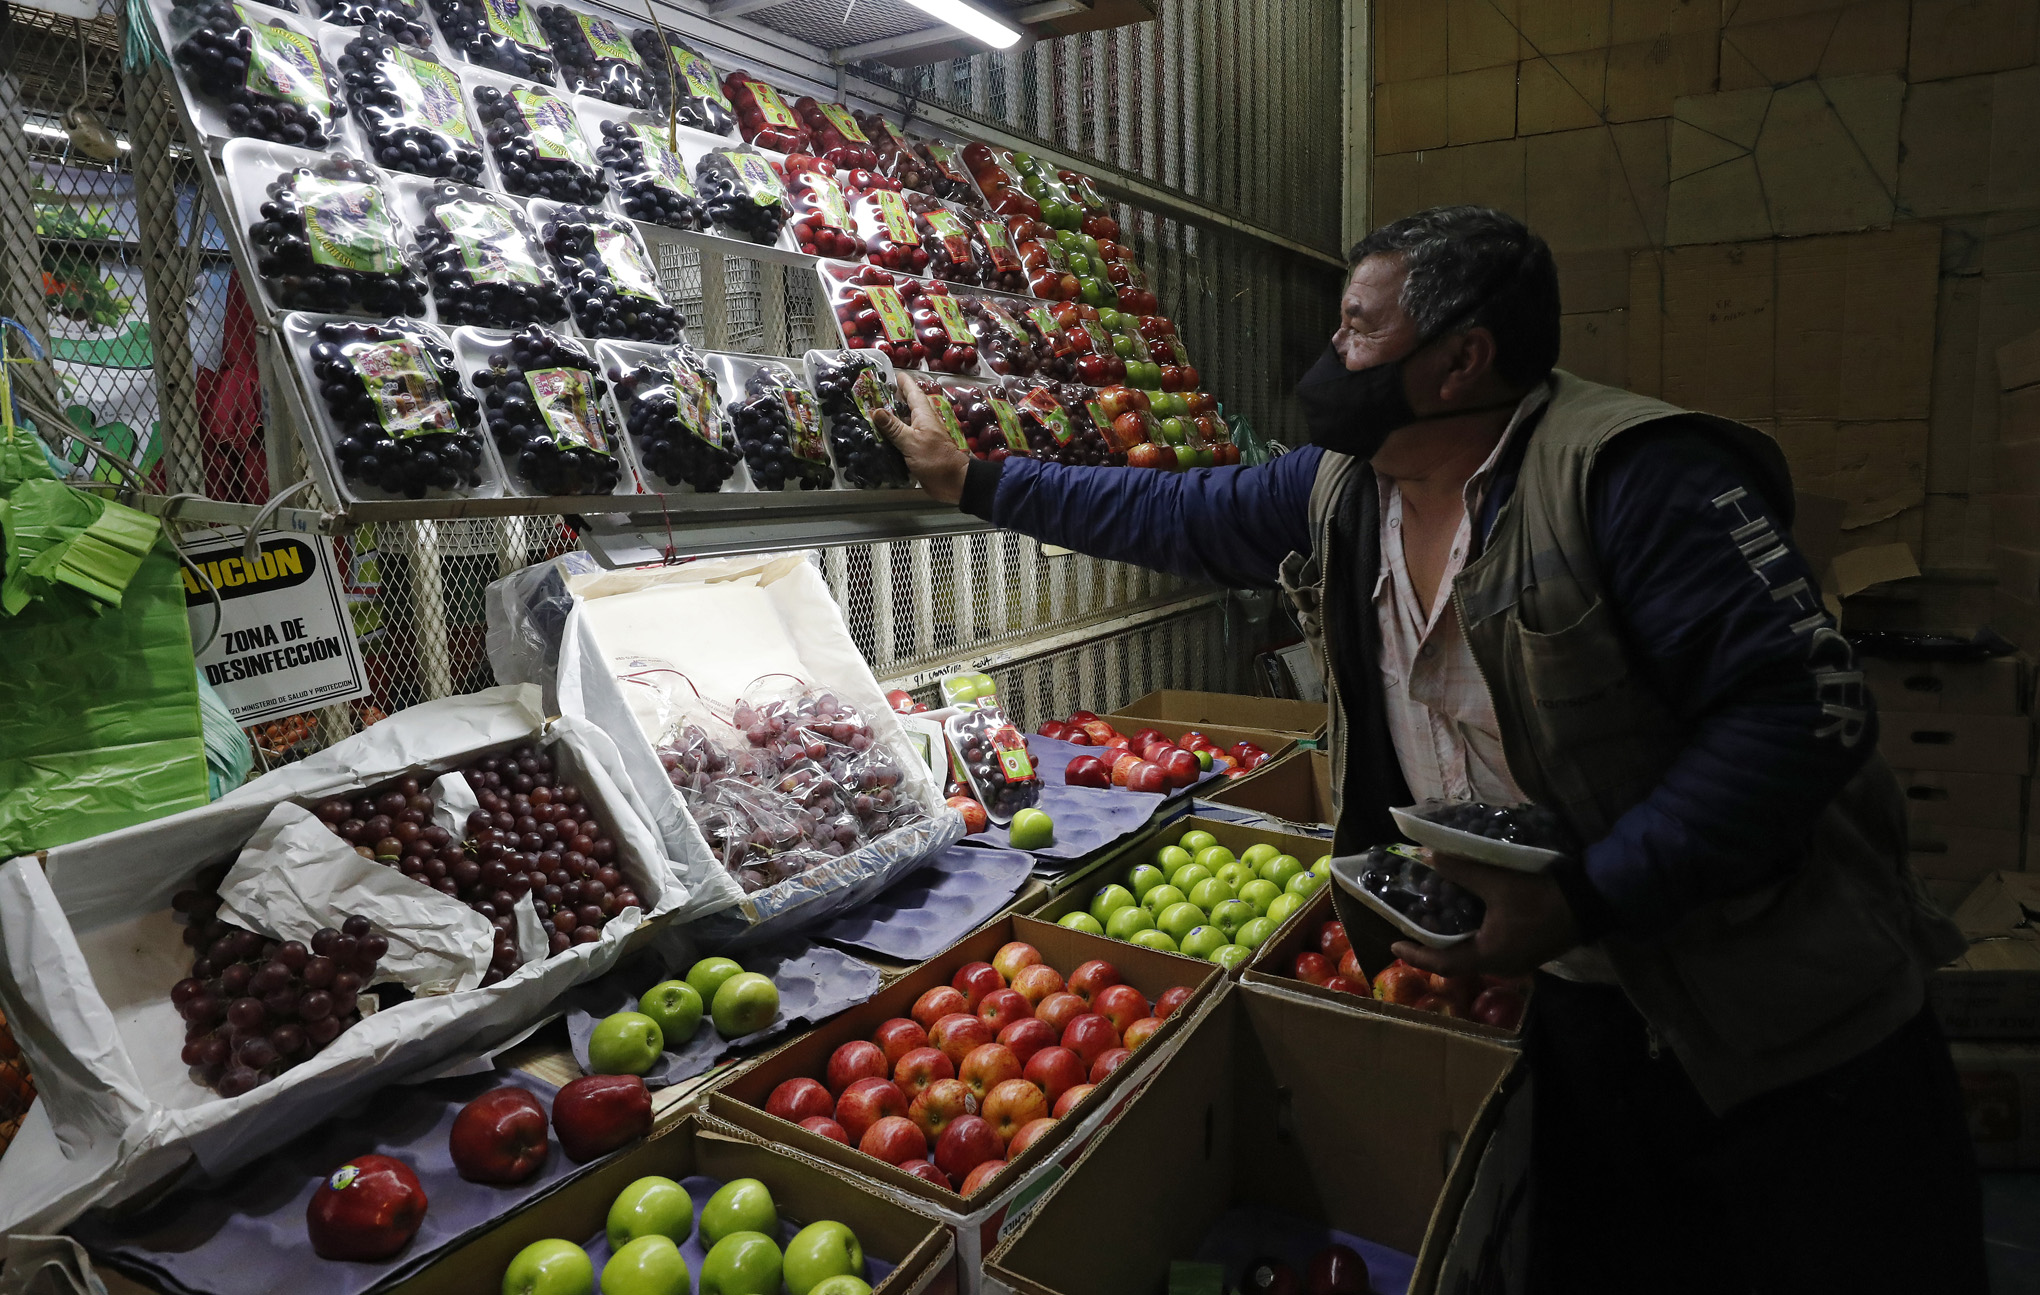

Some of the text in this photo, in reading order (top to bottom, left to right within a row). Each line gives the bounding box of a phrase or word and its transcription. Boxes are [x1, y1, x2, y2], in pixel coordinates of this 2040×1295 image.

[541, 379, 551, 392] 21
[180, 546, 303, 595] AUCION
[221, 617, 308, 655] ZONA DE
[1712, 486, 1867, 748] HILFIGER
[205, 636, 342, 687] DESINFECCIÓN
[241, 698, 277, 712] MINISTERIO
[278, 696, 287, 704] DE
[287, 691, 308, 700] SALUD
